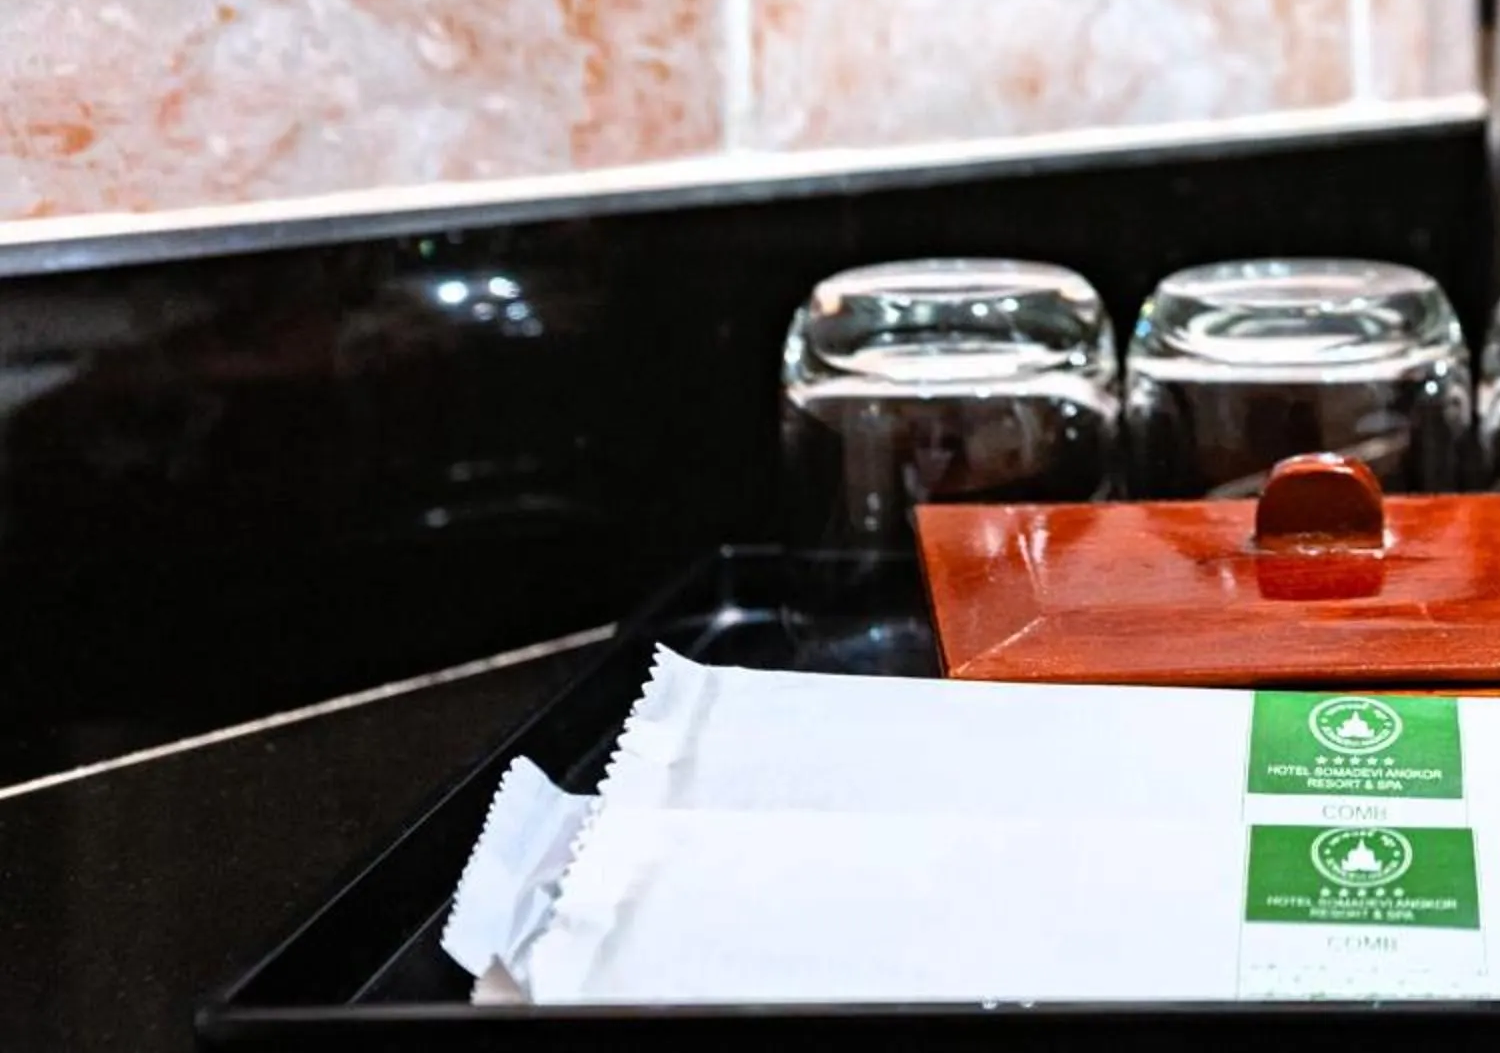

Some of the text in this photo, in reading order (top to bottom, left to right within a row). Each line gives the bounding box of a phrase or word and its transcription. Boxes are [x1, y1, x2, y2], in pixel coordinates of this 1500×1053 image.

[1267, 763, 1442, 780] HOTEL SOMADEVI ANGKOR
[1307, 778, 1403, 791] RESORT & SPA
[1322, 804, 1388, 820] COMB
[1266, 895, 1312, 907] HOTEL
